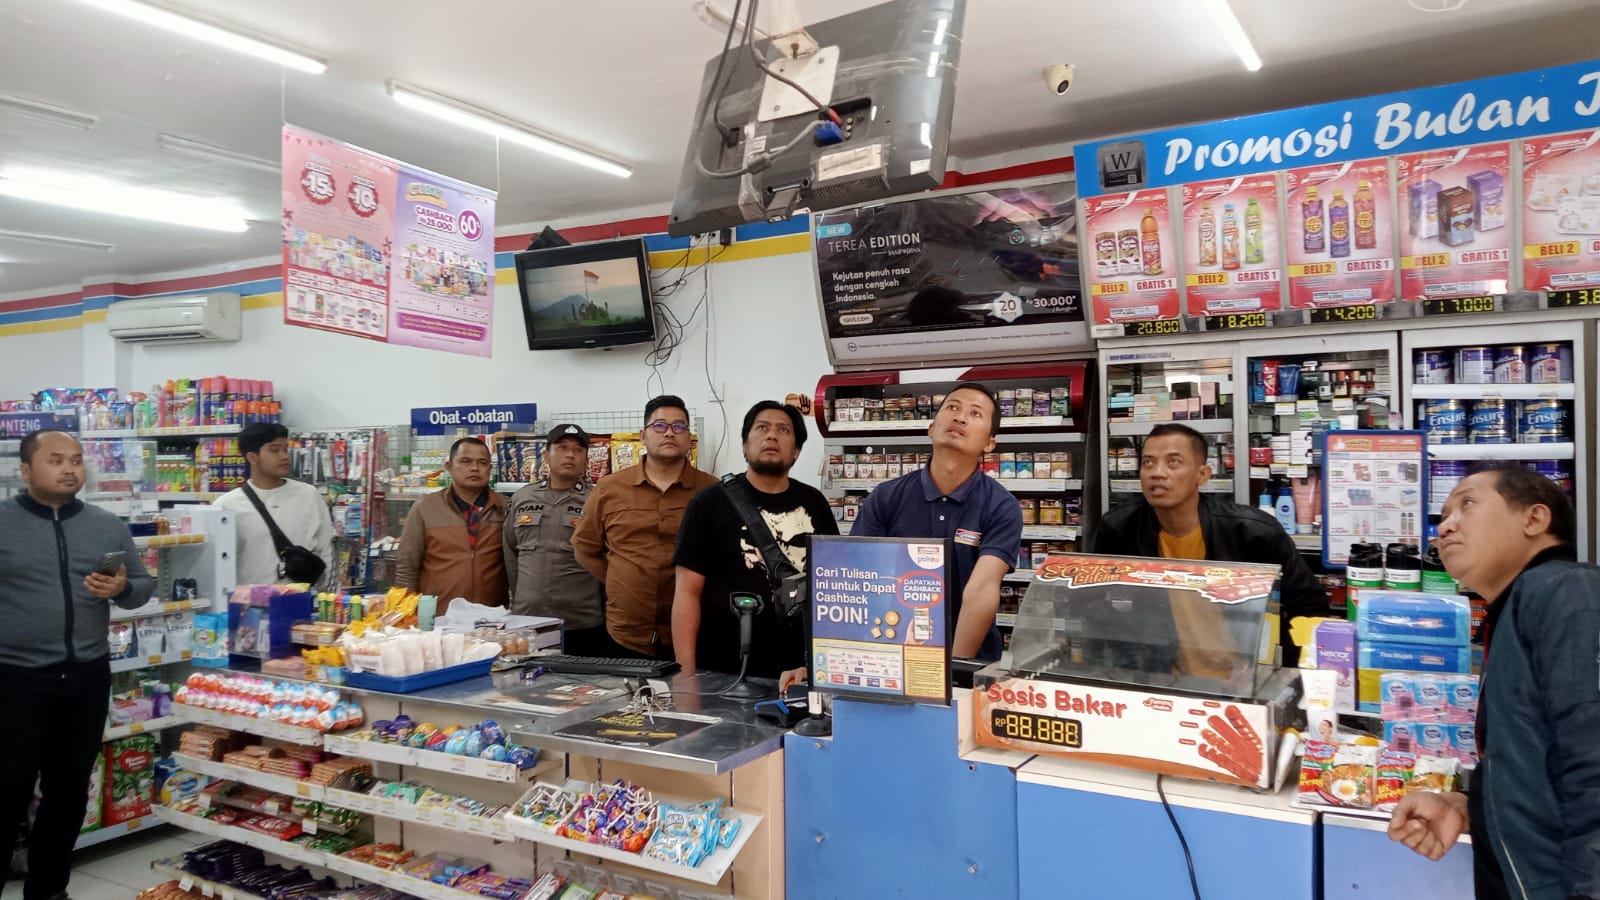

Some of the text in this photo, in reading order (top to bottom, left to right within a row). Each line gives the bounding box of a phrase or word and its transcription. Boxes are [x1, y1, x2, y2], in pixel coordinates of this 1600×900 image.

[1164, 111, 1352, 176] Promosi
[1374, 92, 1551, 150] Bulan
[416, 206, 455, 223] CASHBACK
[828, 232, 920, 252] TEREA EDITION
[1462, 249, 1508, 263] GRATIS 1
[1540, 243, 1574, 256] BELI 2
[1347, 259, 1390, 272] GRATIS 1
[1439, 254, 1445, 265] 2
[833, 267, 910, 282] Kejutan penuh rasa
[1238, 270, 1277, 281] GRATIS 1
[1303, 263, 1332, 274] BELI 2
[834, 278, 900, 293] dengan cengkeh
[1137, 279, 1173, 290] GRATIS 1
[1198, 274, 1224, 284] BELI 2
[1101, 283, 1125, 293] BELI 2
[836, 292, 877, 303] Indonesia.
[1439, 297, 1494, 312] 17.000
[1000, 299, 1017, 311] 20
[1325, 305, 1375, 320] 14.200
[1138, 320, 1179, 335] 20.800
[1219, 313, 1265, 329] 18.200
[429, 408, 514, 425] Obat-obatan
[1429, 412, 1466, 427] Ensure
[1527, 409, 1568, 426] Ensure
[815, 566, 878, 580] Cari Tulisan
[815, 579, 897, 595] ini untuk Dapat
[904, 585, 942, 593] CASHBACK
[815, 591, 869, 605] Cashback
[904, 592, 931, 602] POIN
[816, 604, 869, 625] POIN!
[987, 682, 1047, 709] Sosis
[1055, 689, 1128, 719] Bakar
